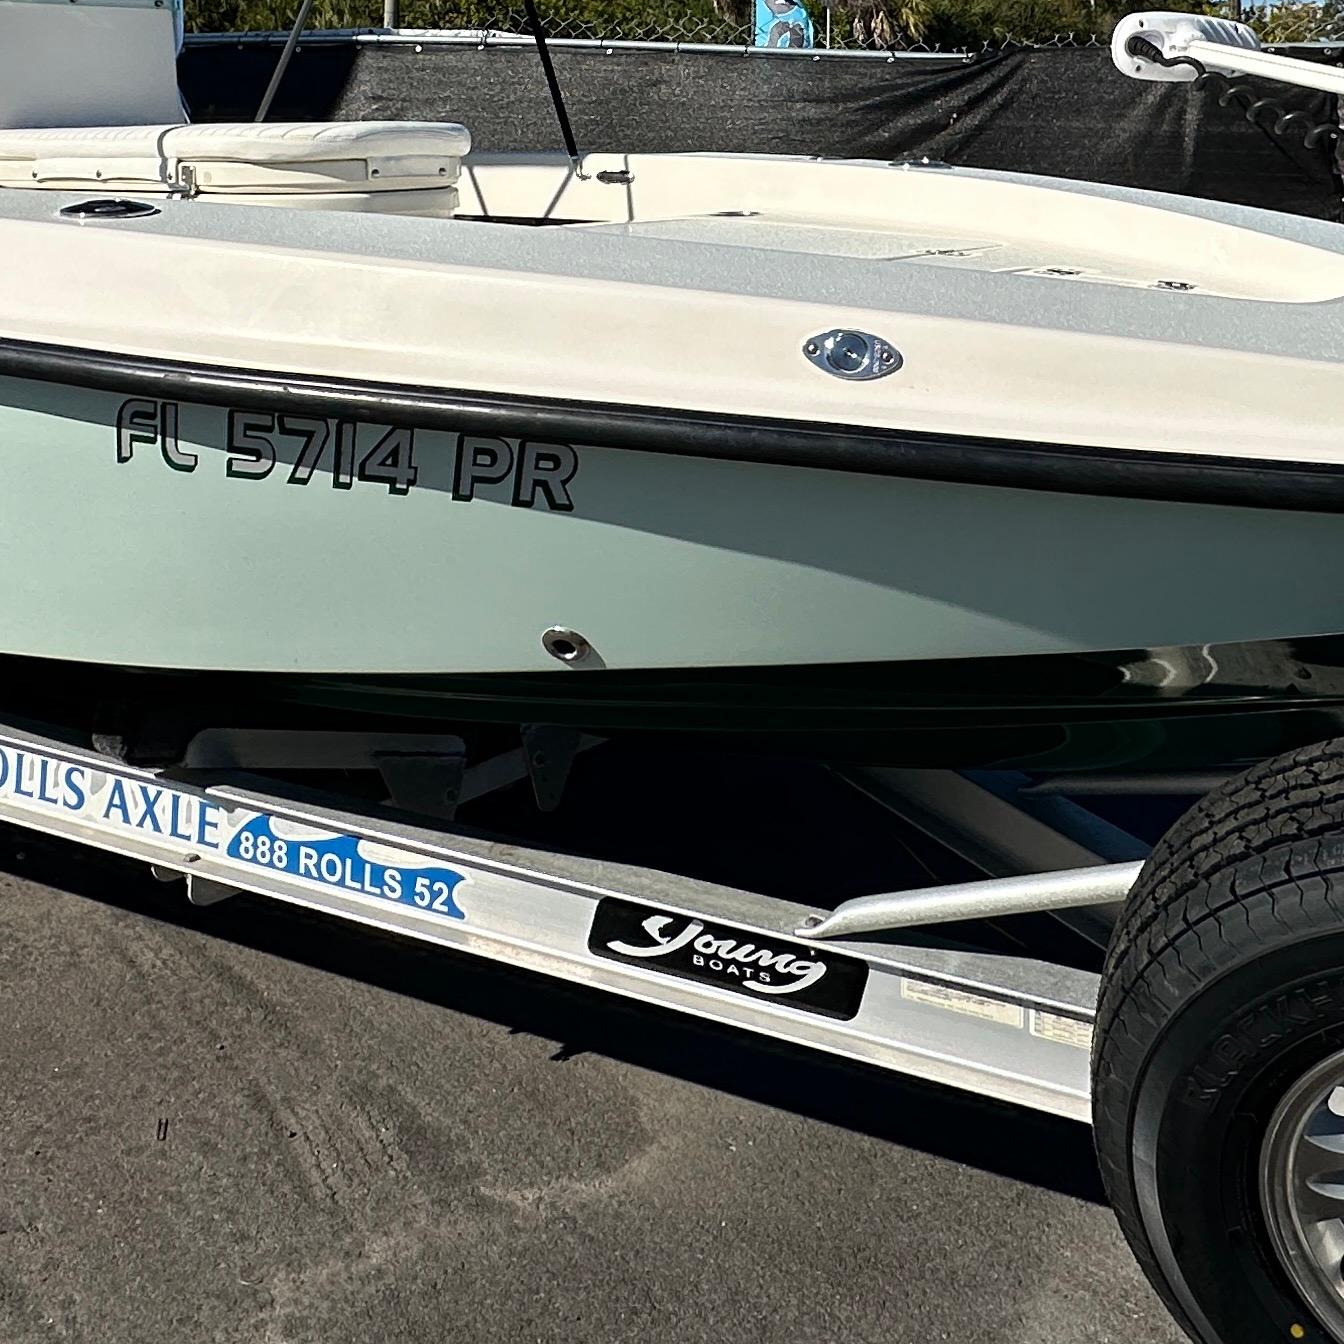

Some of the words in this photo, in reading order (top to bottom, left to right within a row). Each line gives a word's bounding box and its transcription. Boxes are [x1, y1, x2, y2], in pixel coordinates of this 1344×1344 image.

[116, 399, 198, 473] FL
[226, 411, 419, 496] 5714
[453, 435, 580, 512] PR
[104, 778, 222, 850] AXLE
[239, 831, 288, 869] 888
[298, 845, 402, 900] ROLLS
[414, 877, 451, 915] 52
[692, 954, 771, 983] BOATS
